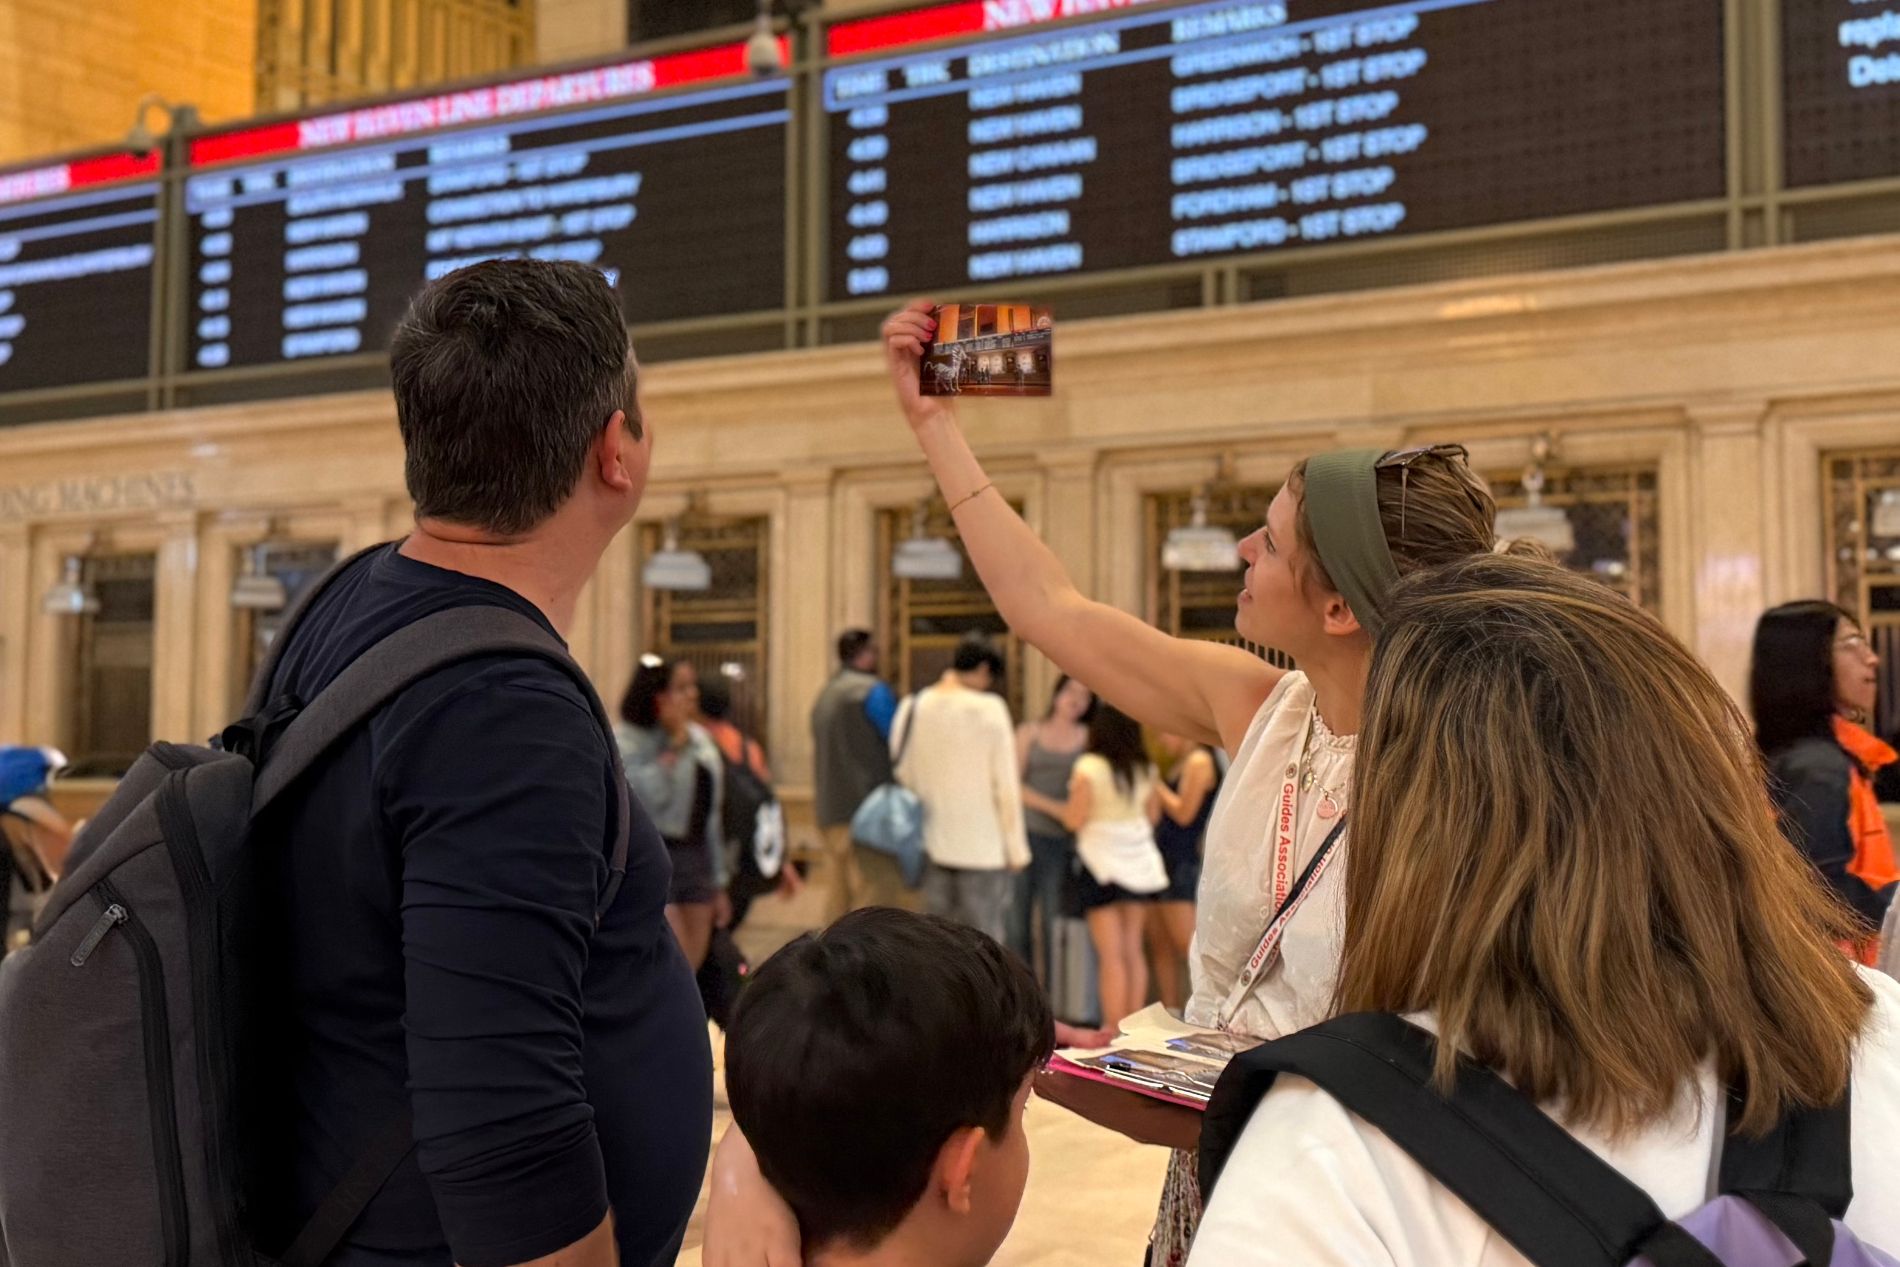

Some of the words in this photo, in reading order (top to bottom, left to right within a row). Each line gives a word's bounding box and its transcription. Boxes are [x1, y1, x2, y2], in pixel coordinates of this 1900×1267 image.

[1354, 13, 1419, 48] STOP
[1361, 48, 1427, 84] STOP
[1335, 90, 1398, 125] STOP
[1361, 123, 1427, 159] STOP
[1330, 165, 1395, 200] STOP
[1341, 201, 1406, 236] STOP
[1280, 783, 1294, 832] Guides
[1274, 835, 1292, 912] Associatio
[1250, 927, 1279, 970] Guides
